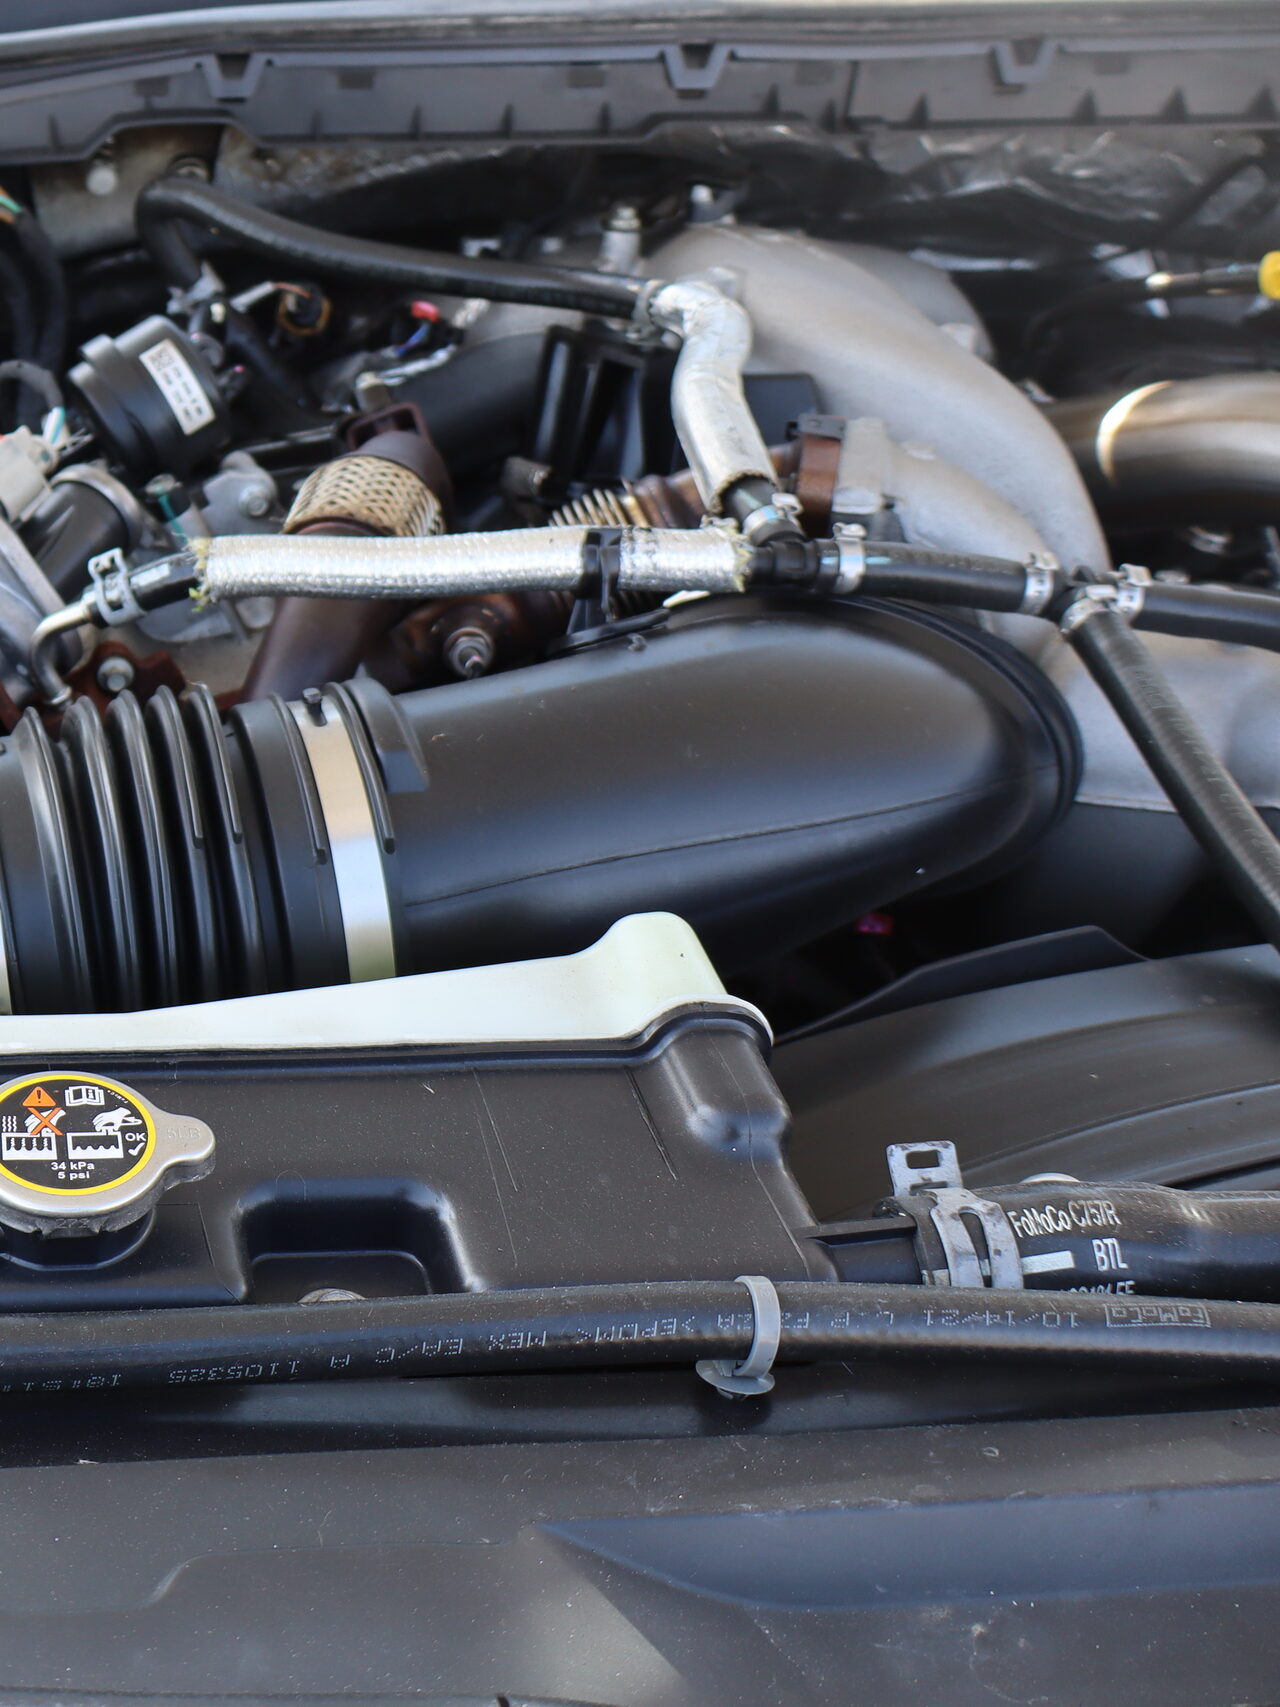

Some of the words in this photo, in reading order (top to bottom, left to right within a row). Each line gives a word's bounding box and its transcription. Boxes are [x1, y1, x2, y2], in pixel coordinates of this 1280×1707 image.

[125, 1132, 147, 1142] OK
[51, 1161, 67, 1171] 34
[70, 1161, 95, 1171] kPa
[57, 1171, 66, 1179] 5
[69, 1171, 90, 1180] psi
[1007, 1205, 1072, 1239] FoMoCo
[1068, 1200, 1122, 1228] C757R
[1092, 1237, 1129, 1272] BTL
[1110, 1305, 1205, 1323] FoMoCo
[330, 1354, 351, 1369] A
